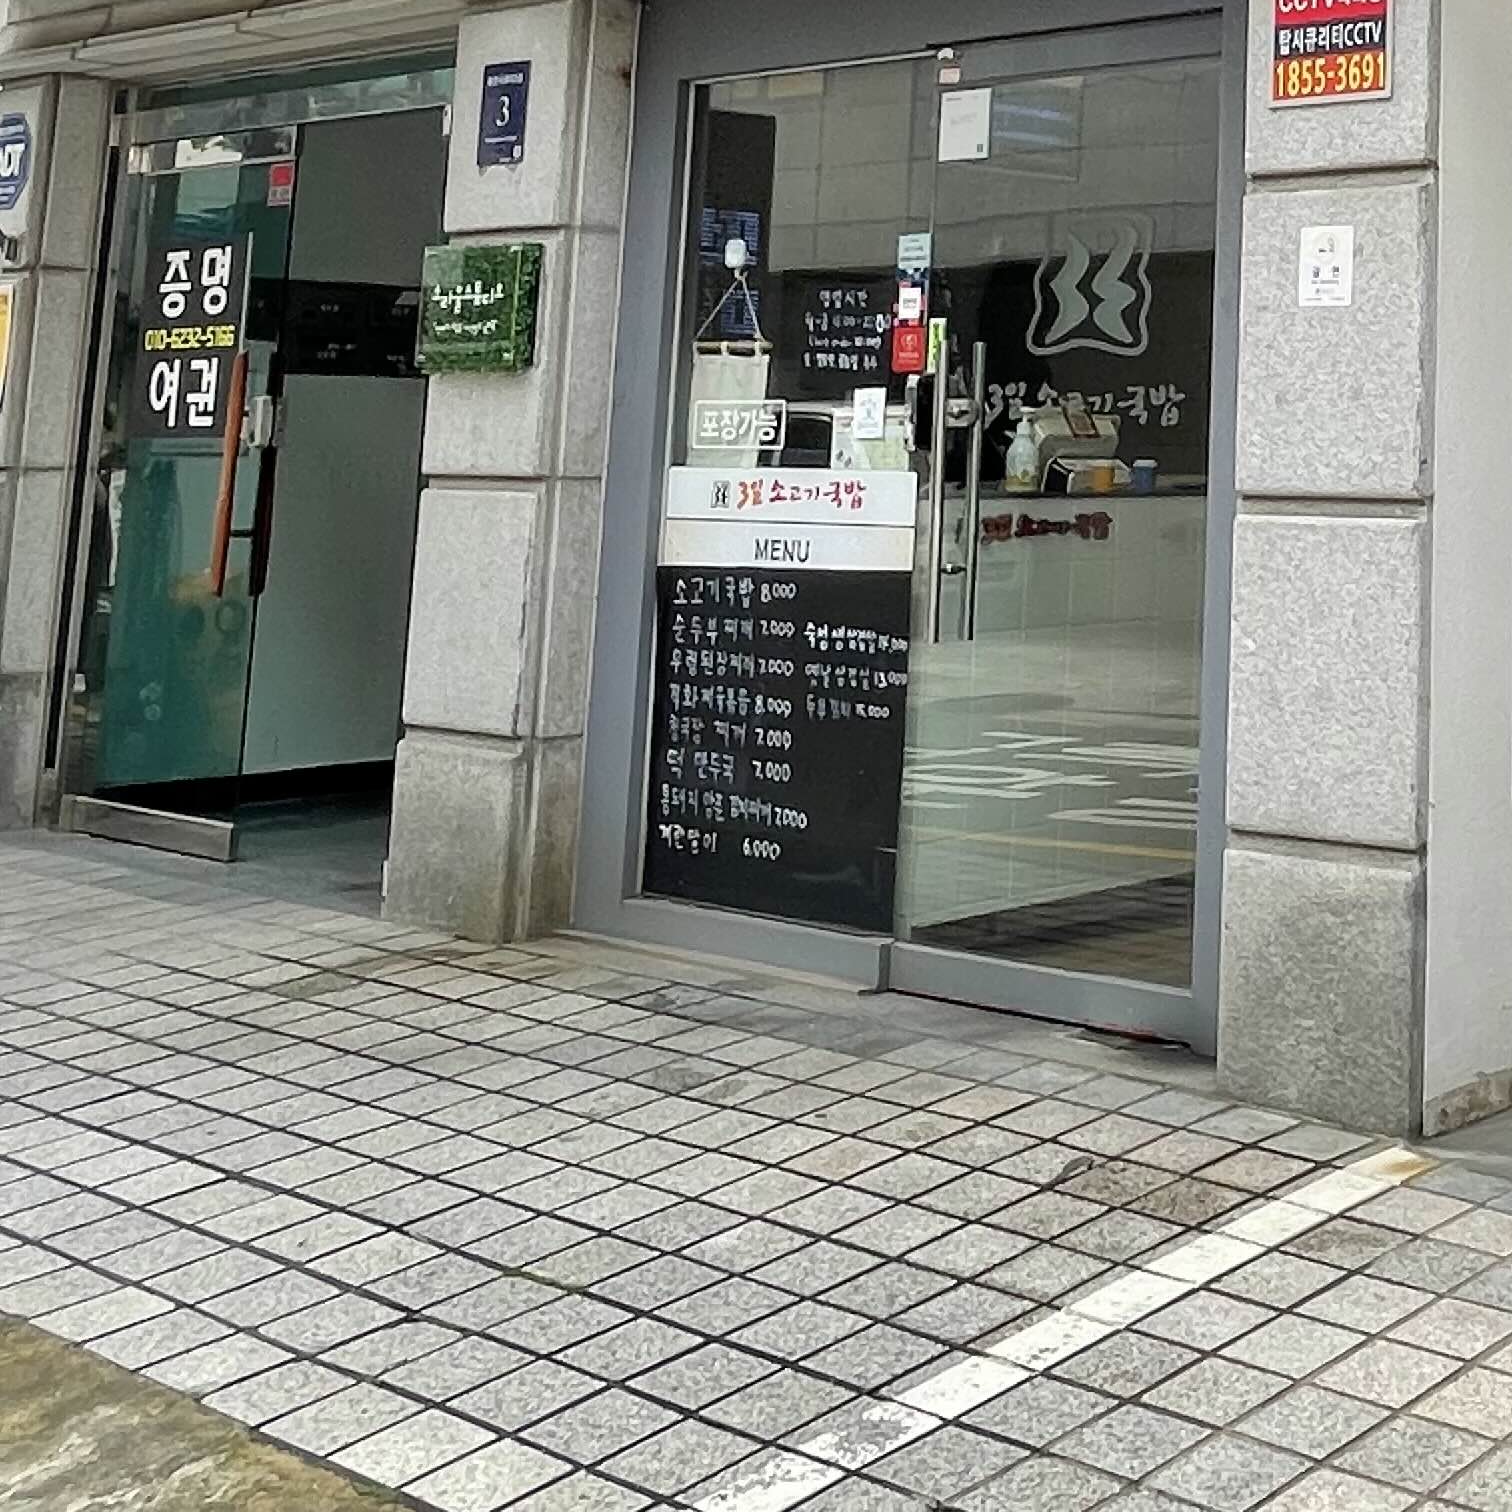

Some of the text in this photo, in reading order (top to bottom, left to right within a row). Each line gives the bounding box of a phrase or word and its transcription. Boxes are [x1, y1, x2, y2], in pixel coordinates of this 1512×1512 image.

[1276, 52, 1385, 97] 1855-3691
[496, 95, 511, 127] 3
[700, 406, 778, 442] 포장가능
[768, 478, 867, 510] 소고기국밥
[754, 537, 811, 563] MENU
